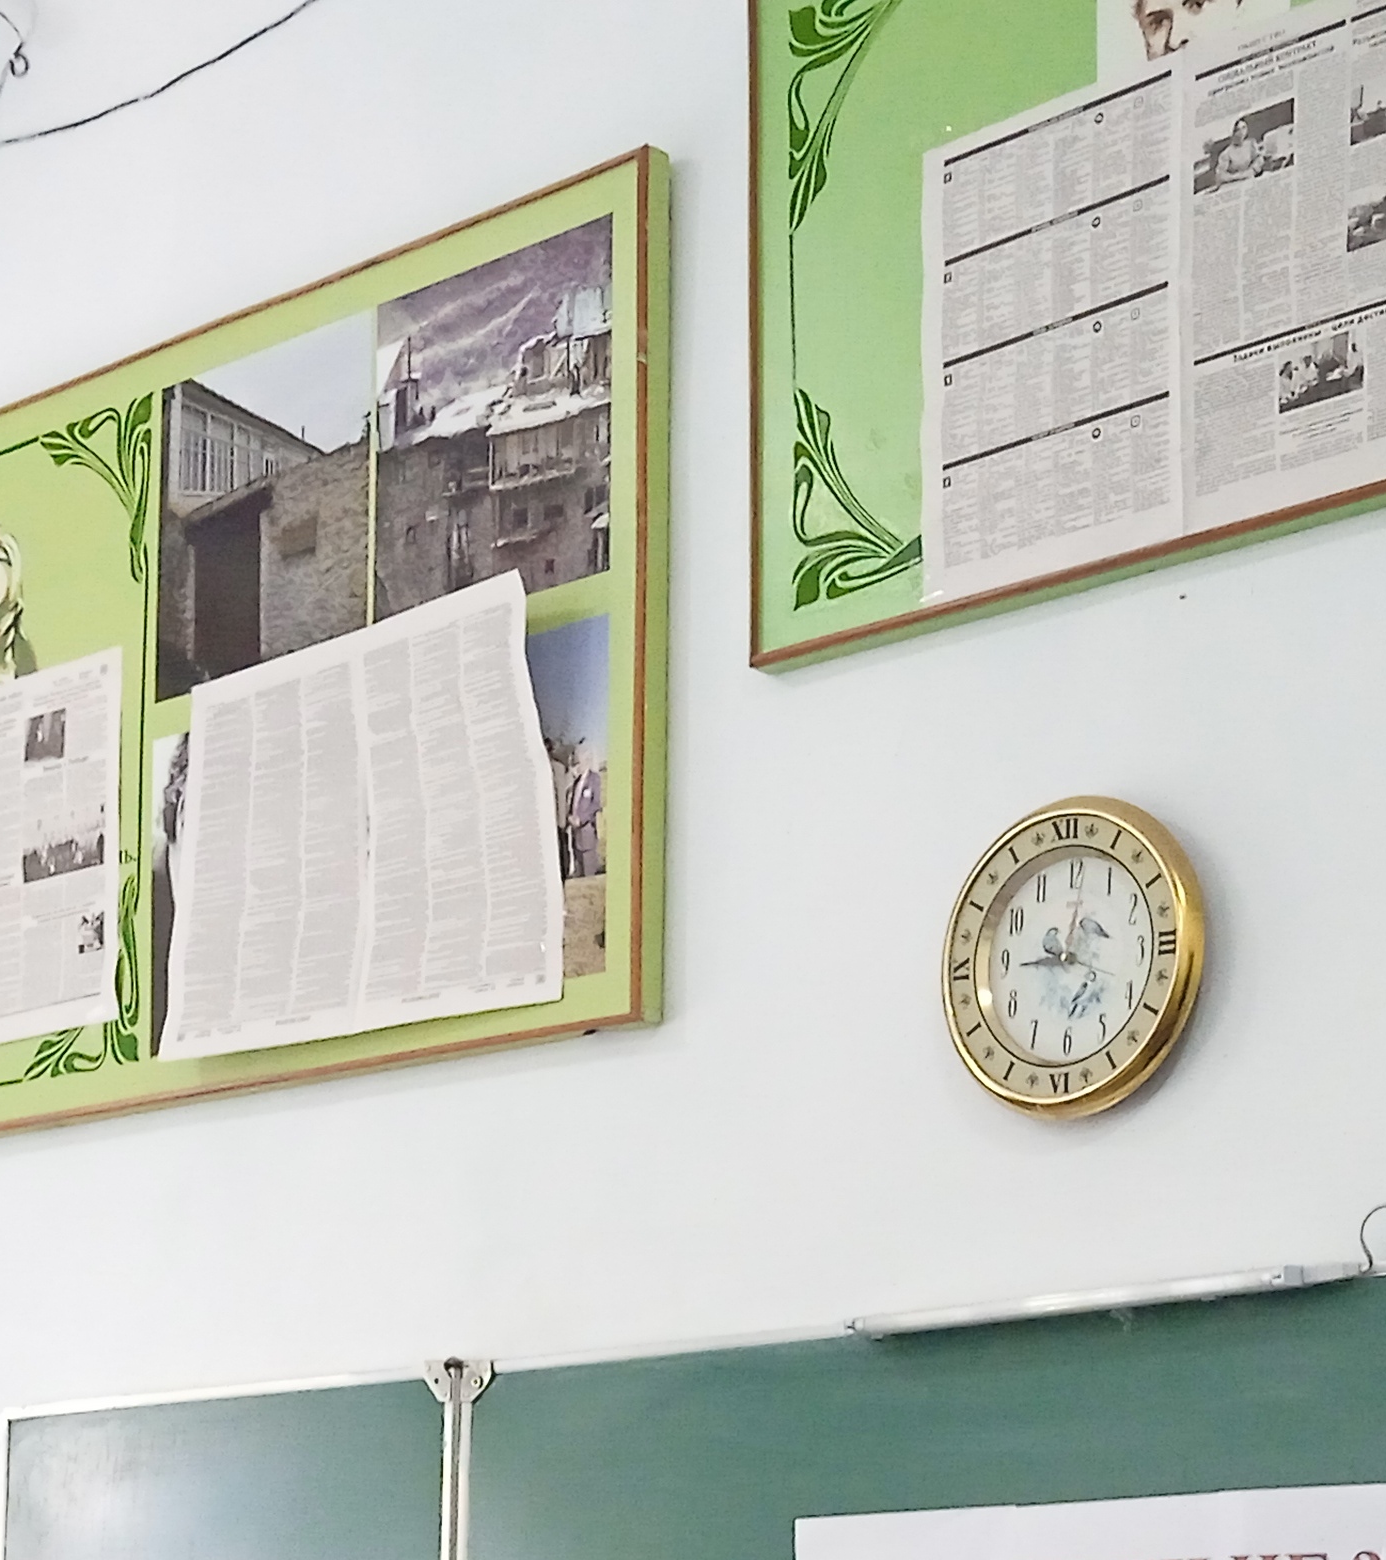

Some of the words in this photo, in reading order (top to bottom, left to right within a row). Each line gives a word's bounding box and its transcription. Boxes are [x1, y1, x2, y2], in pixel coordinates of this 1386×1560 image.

[1052, 818, 1079, 840] XII
[1036, 871, 1047, 902] 11
[1009, 906, 1024, 936] 10
[1128, 893, 1138, 925] 2
[1001, 948, 1010, 979] 9
[1136, 934, 1145, 967] 3
[1008, 989, 1018, 1018] 8
[1124, 980, 1133, 1010] 4
[1030, 1019, 1039, 1050] 7
[1062, 1027, 1072, 1056] 6
[1098, 1013, 1107, 1044] 5
[1049, 1072, 1070, 1094] VI
